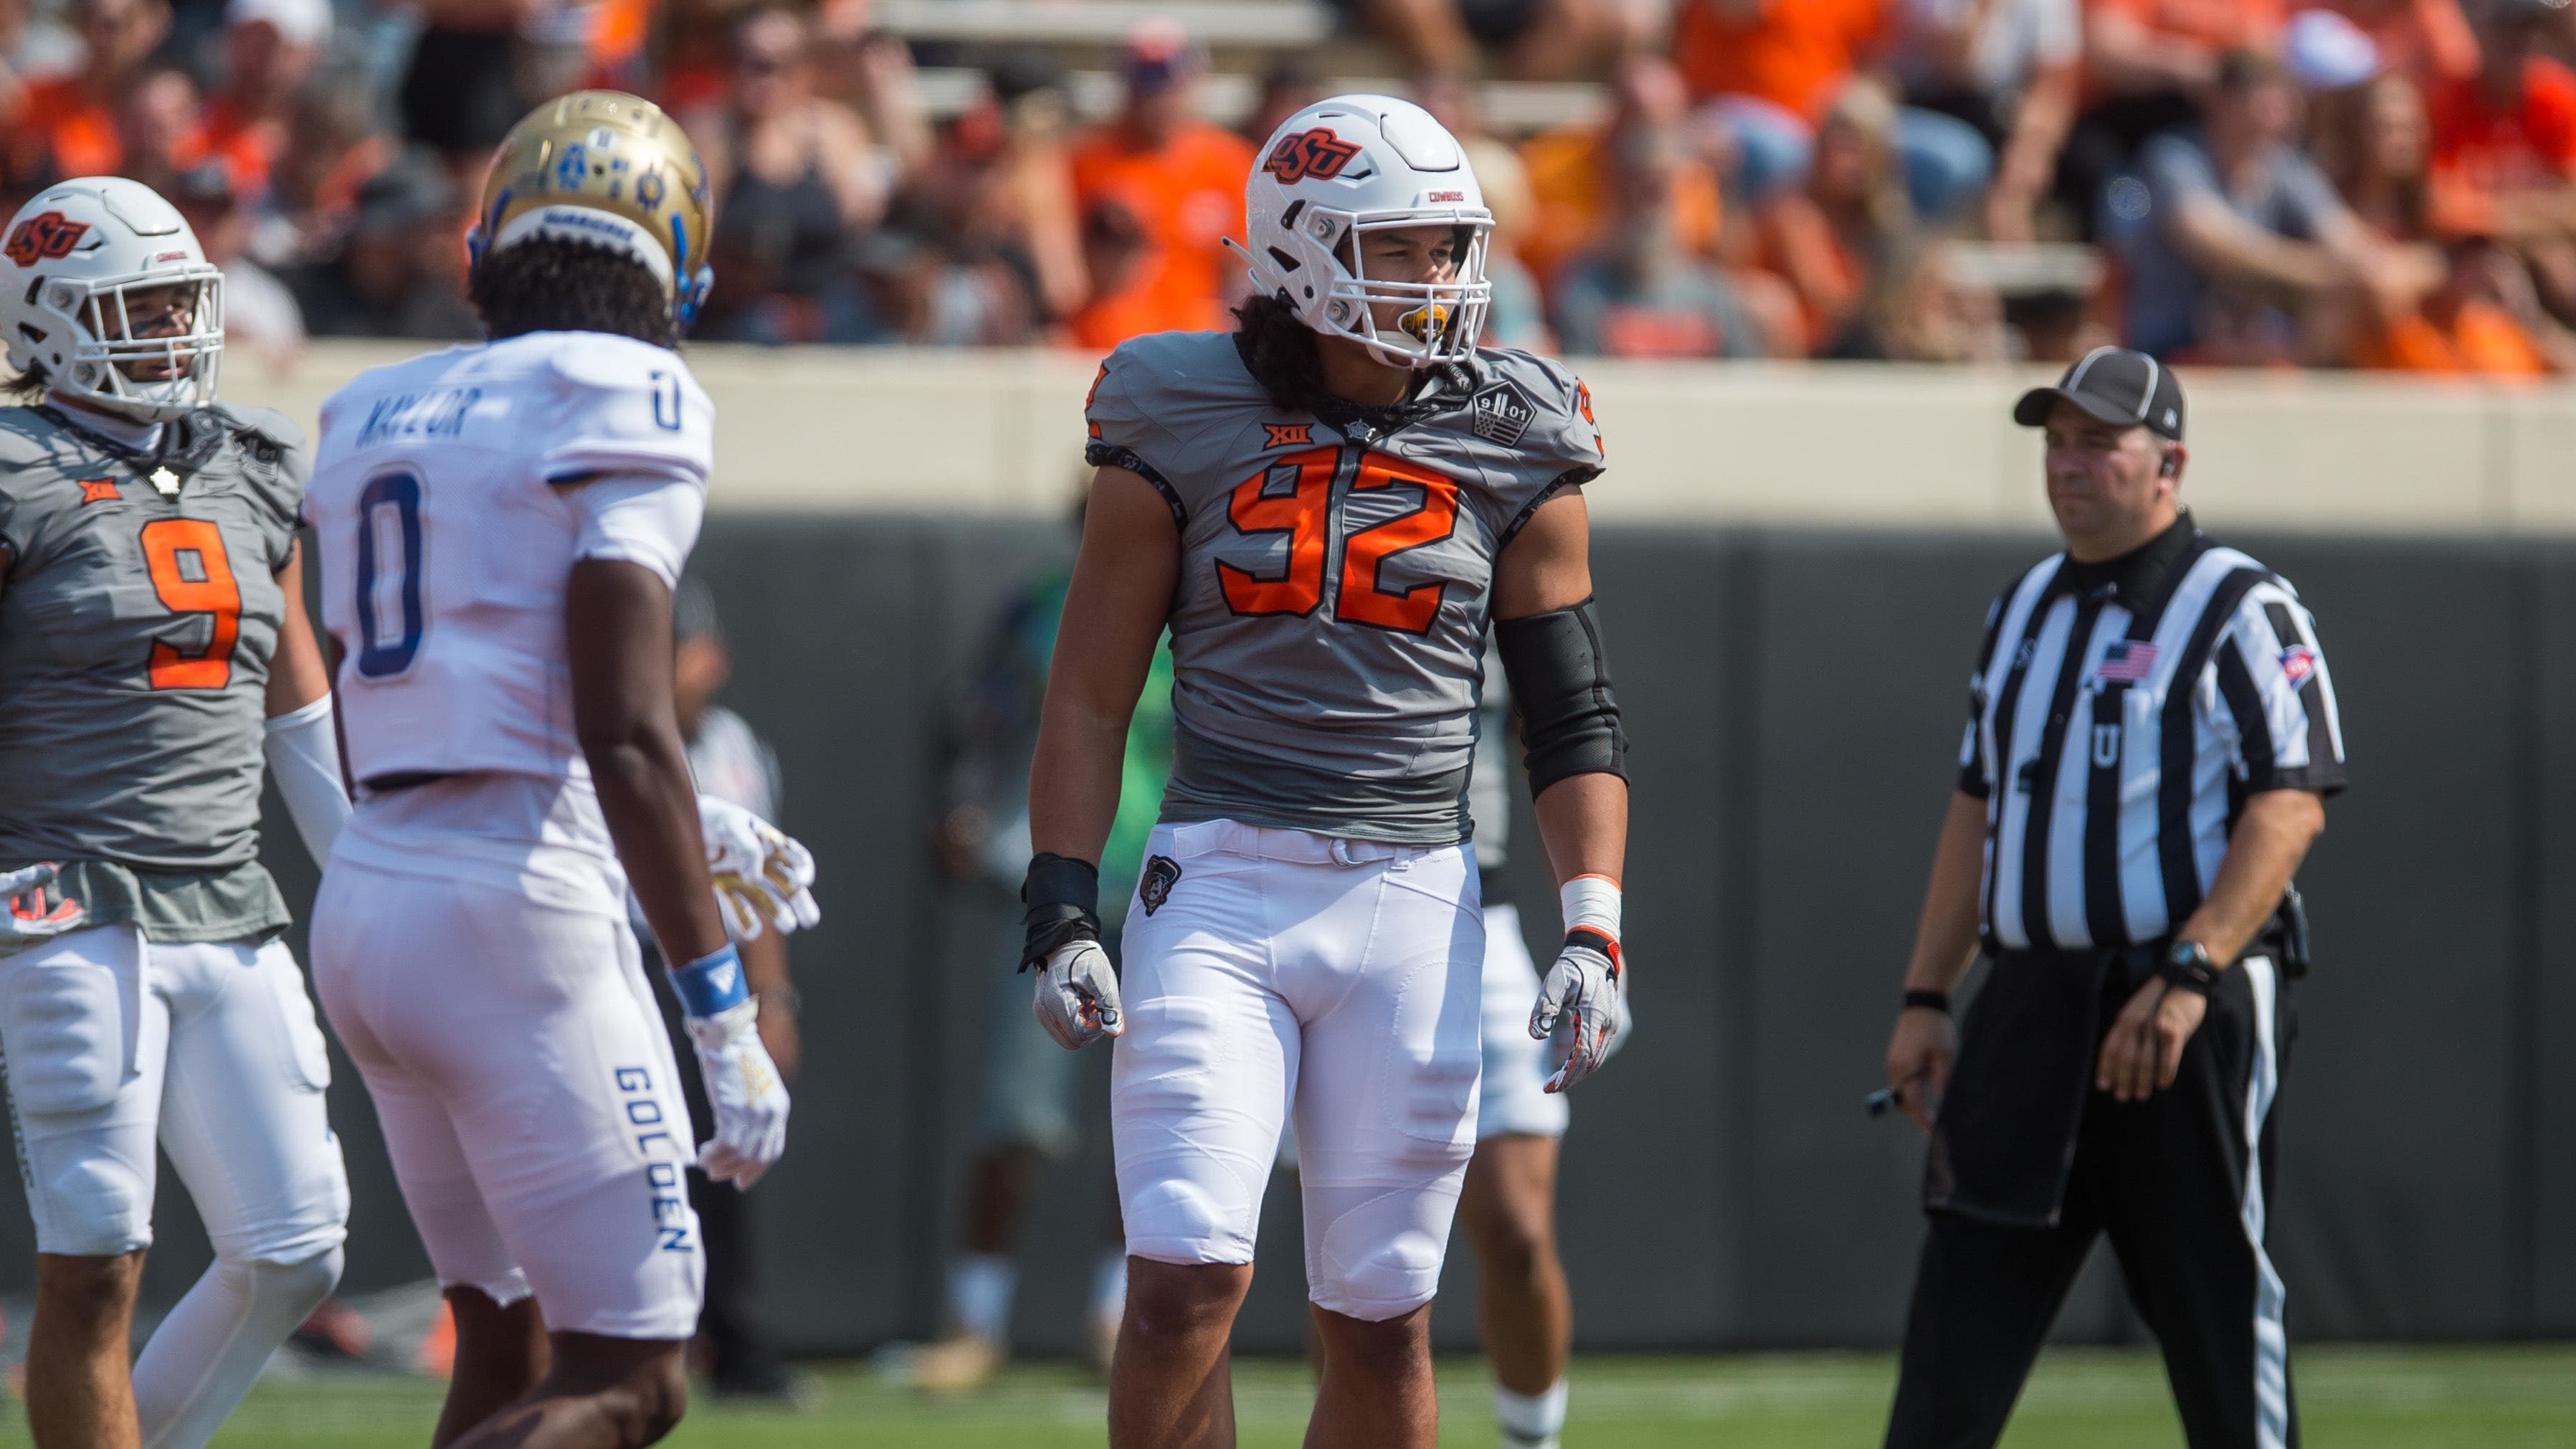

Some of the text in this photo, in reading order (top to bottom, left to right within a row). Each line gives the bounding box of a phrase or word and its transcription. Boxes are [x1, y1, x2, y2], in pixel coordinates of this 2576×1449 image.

[1261, 126, 1362, 185] OSU
[1428, 191, 1464, 202] COWBOYS
[5, 210, 91, 268] OSU
[1260, 422, 1316, 452] XII
[1215, 445, 1460, 637] 92
[138, 517, 242, 690] 9
[354, 465, 426, 683] 0
[2092, 723, 2122, 769] U
[614, 1065, 694, 1255] GOLDEN
